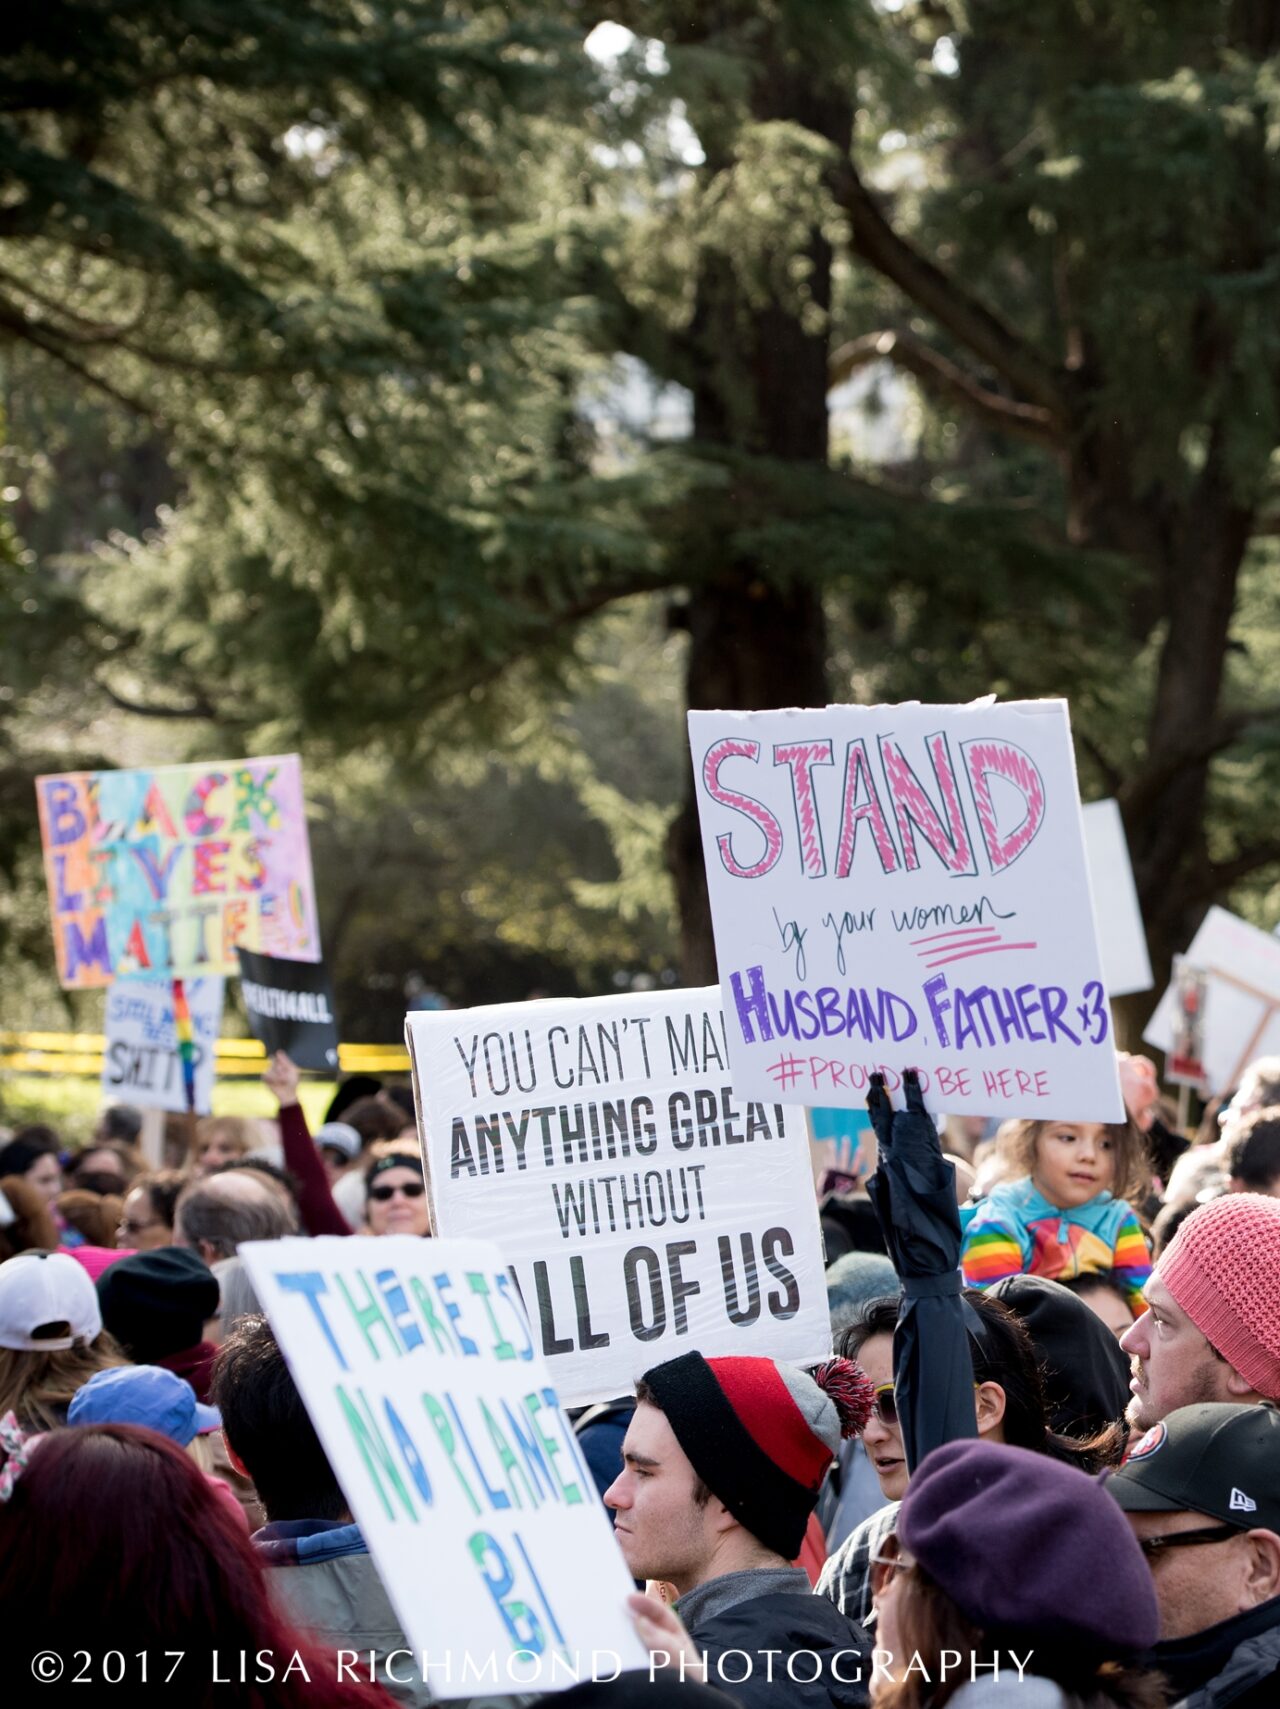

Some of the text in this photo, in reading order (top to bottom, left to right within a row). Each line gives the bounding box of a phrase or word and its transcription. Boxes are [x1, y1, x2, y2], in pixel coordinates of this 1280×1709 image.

[45, 767, 281, 847] BLACK
[702, 730, 1047, 879] STAND
[53, 832, 271, 914] LIVES
[772, 895, 1017, 982] by your women
[453, 1010, 731, 1098] YOU CAN'T MA
[922, 972, 1082, 1050] FATHER
[935, 1066, 972, 1096] BE
[985, 1068, 1051, 1099] HERE
[450, 1086, 786, 1179] ANYTHING GREAT
[552, 1165, 706, 1238] WITHOUT
[273, 1268, 535, 1372] THERE IS
[623, 1240, 701, 1343] OF
[717, 1226, 801, 1327] US
[333, 1383, 604, 1523] NO PLANET
